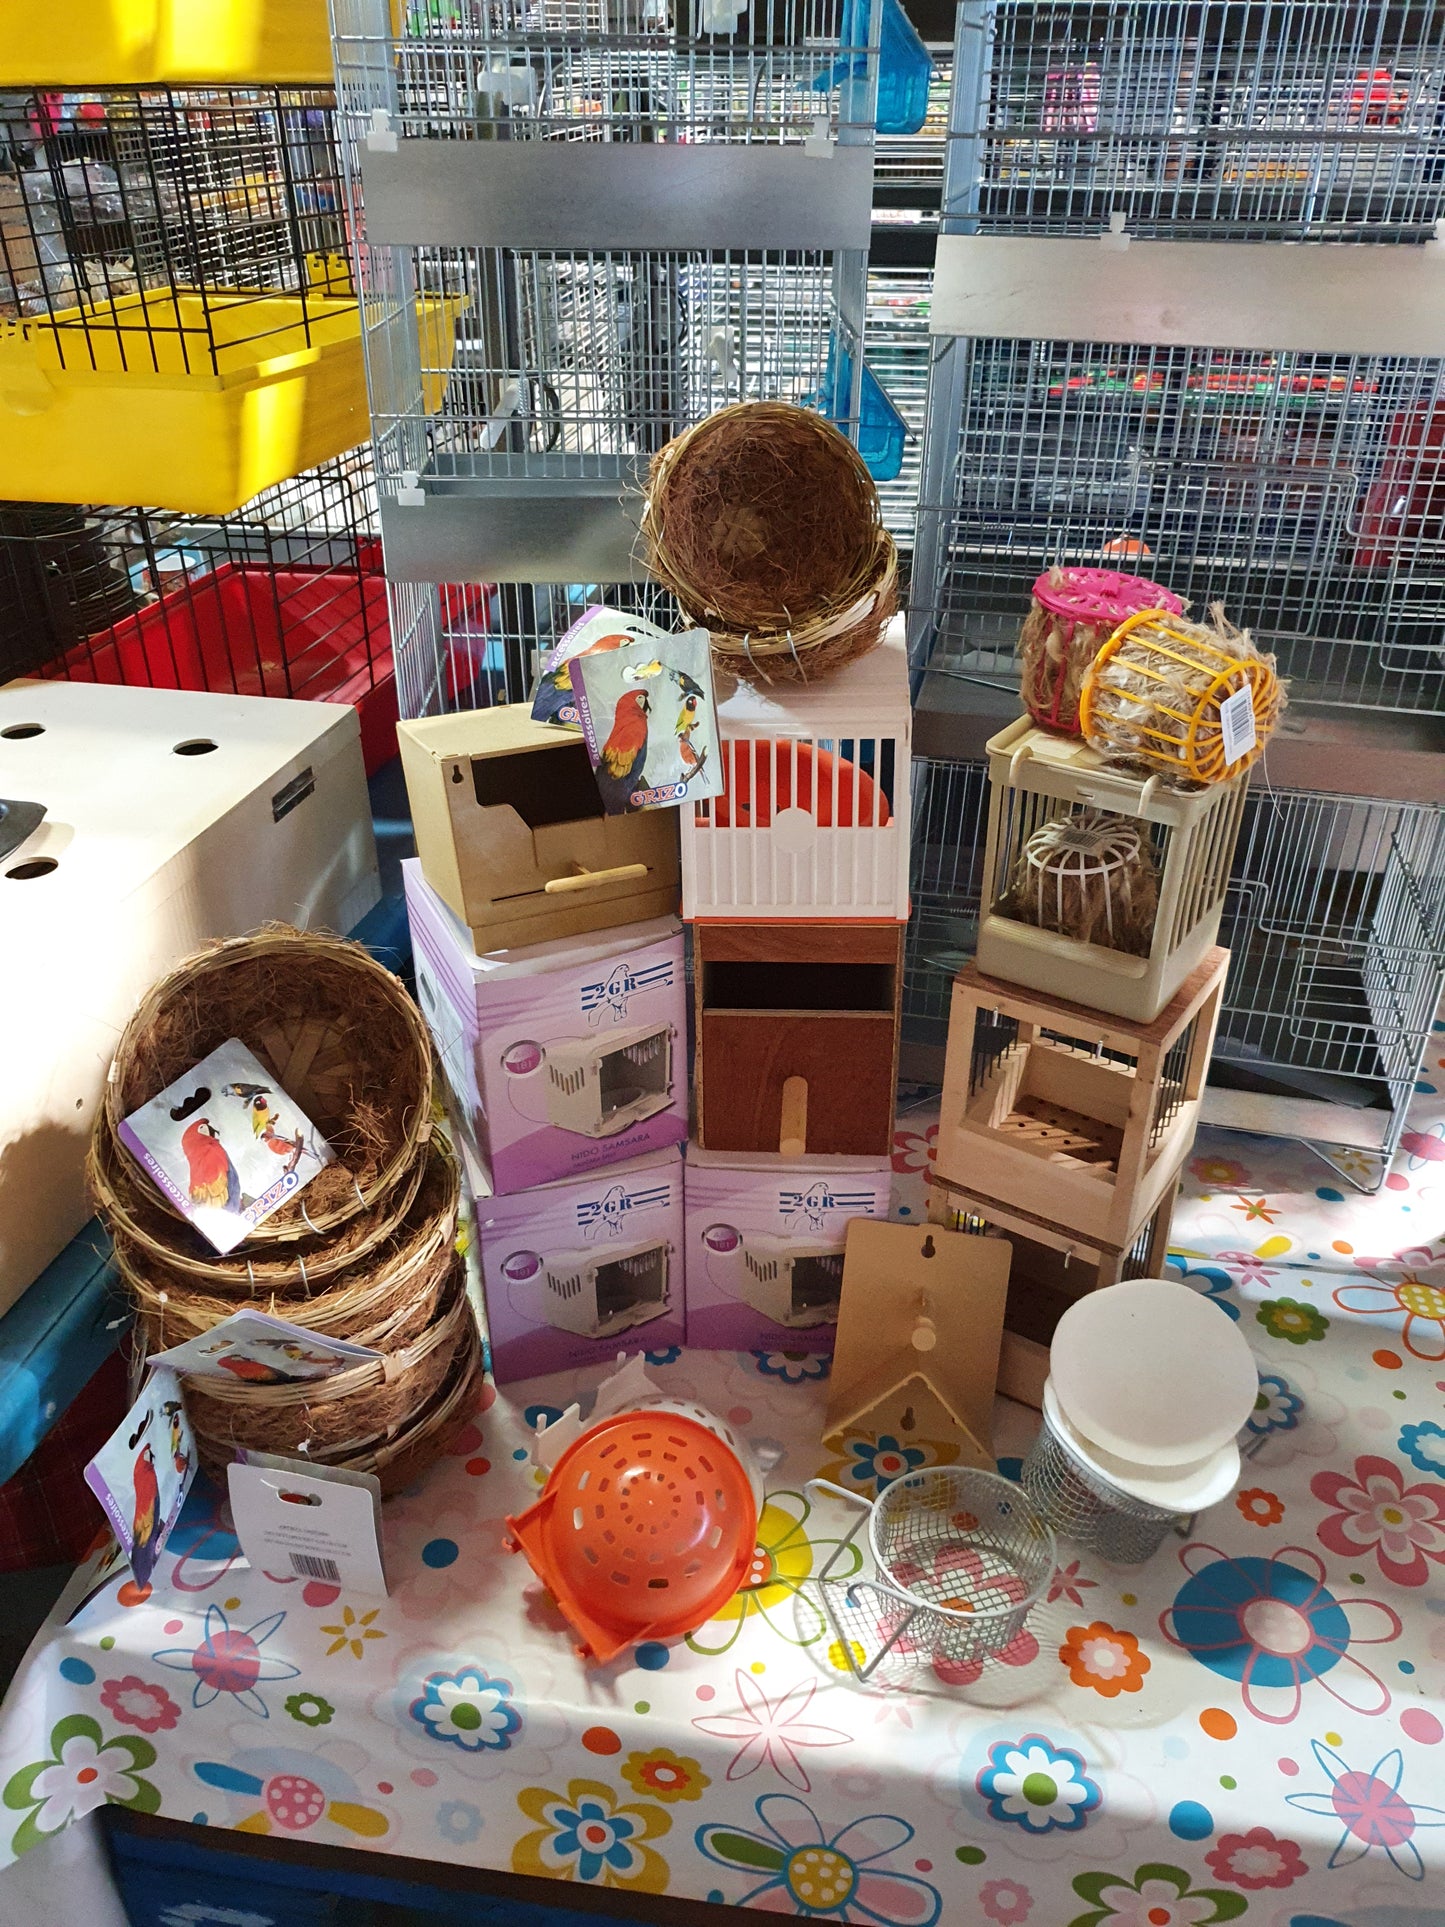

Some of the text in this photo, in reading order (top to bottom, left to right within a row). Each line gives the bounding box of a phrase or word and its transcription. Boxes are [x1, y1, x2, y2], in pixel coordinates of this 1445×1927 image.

[551, 621, 585, 668] accessoires
[580, 695, 600, 761] accessoires
[630, 782, 687, 806] GRIZO
[594, 976, 637, 999] 2GR
[571, 1146, 599, 1161] NIDO
[601, 1132, 651, 1153] SAMSARA
[143, 1152, 190, 1210] accessoires
[591, 1196, 633, 1218] 2GR
[793, 1194, 836, 1209] 2GR
[105, 1492, 134, 1547] accessoires
